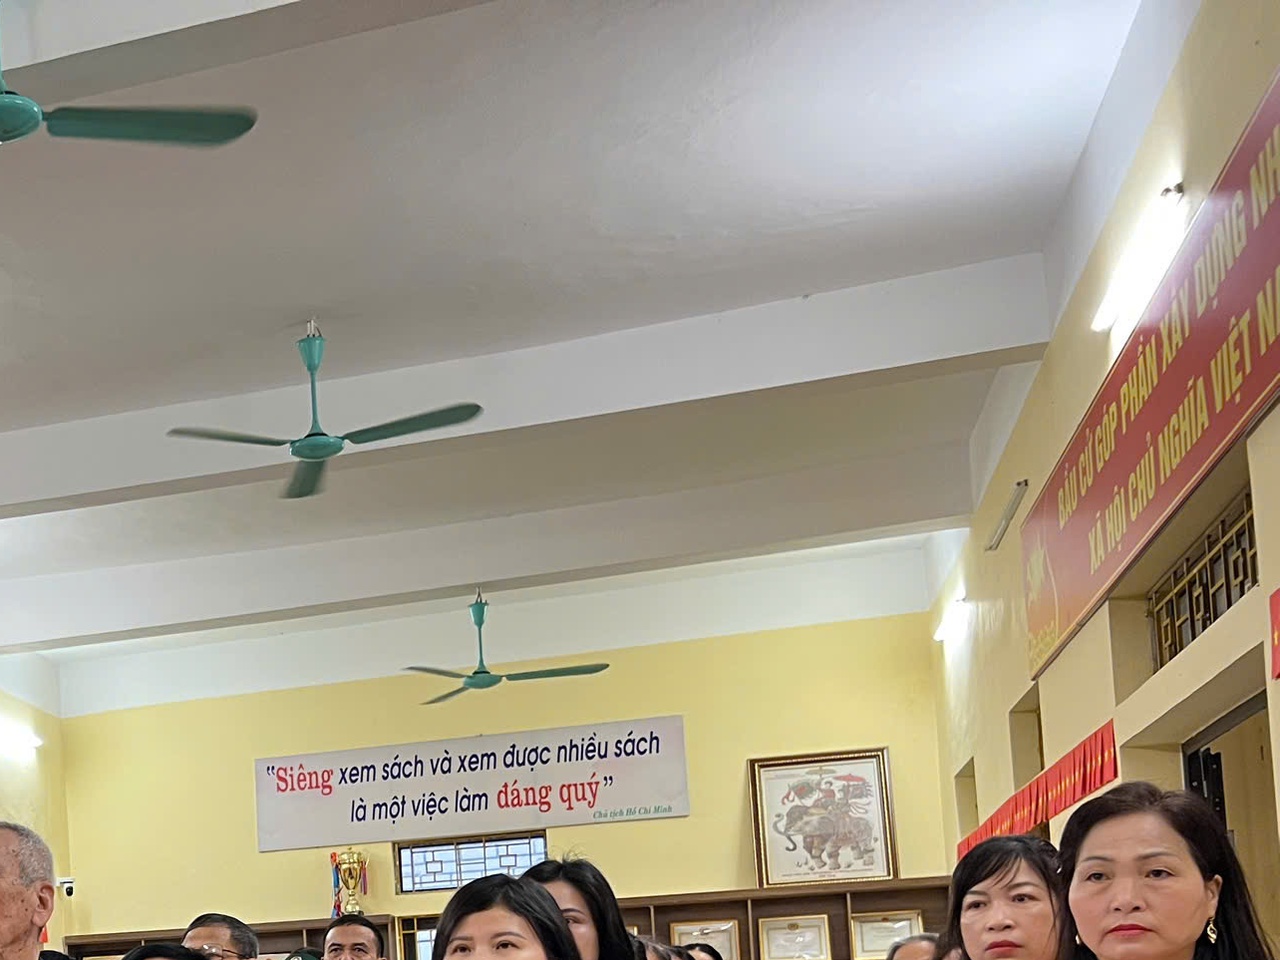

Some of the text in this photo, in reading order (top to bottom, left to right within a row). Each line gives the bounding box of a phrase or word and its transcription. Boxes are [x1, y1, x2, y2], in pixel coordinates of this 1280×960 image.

[1057, 463, 1078, 531] BẦU
[1078, 428, 1094, 497] CỬ
[1094, 403, 1117, 473] GÓP
[1119, 335, 1158, 435] PHẦN
[1160, 278, 1190, 374] XÂY
[1194, 189, 1247, 319] DỰNG
[1088, 510, 1105, 575] XÃ
[1105, 485, 1127, 551] HỘI
[1128, 431, 1156, 522] CHỦ
[1158, 375, 1209, 485] NGHĨA
[1210, 308, 1252, 414] VIỆT
[338, 764, 376, 785] xem
[382, 754, 423, 781] sách
[430, 750, 451, 775] và
[457, 751, 497, 773] xem
[503, 743, 550, 771] được
[557, 732, 608, 763] nhiều
[614, 730, 660, 757] sách
[351, 798, 366, 822] là
[372, 795, 406, 824] một
[411, 792, 449, 821] việc
[455, 787, 488, 812] làm
[497, 779, 552, 813] đáng
